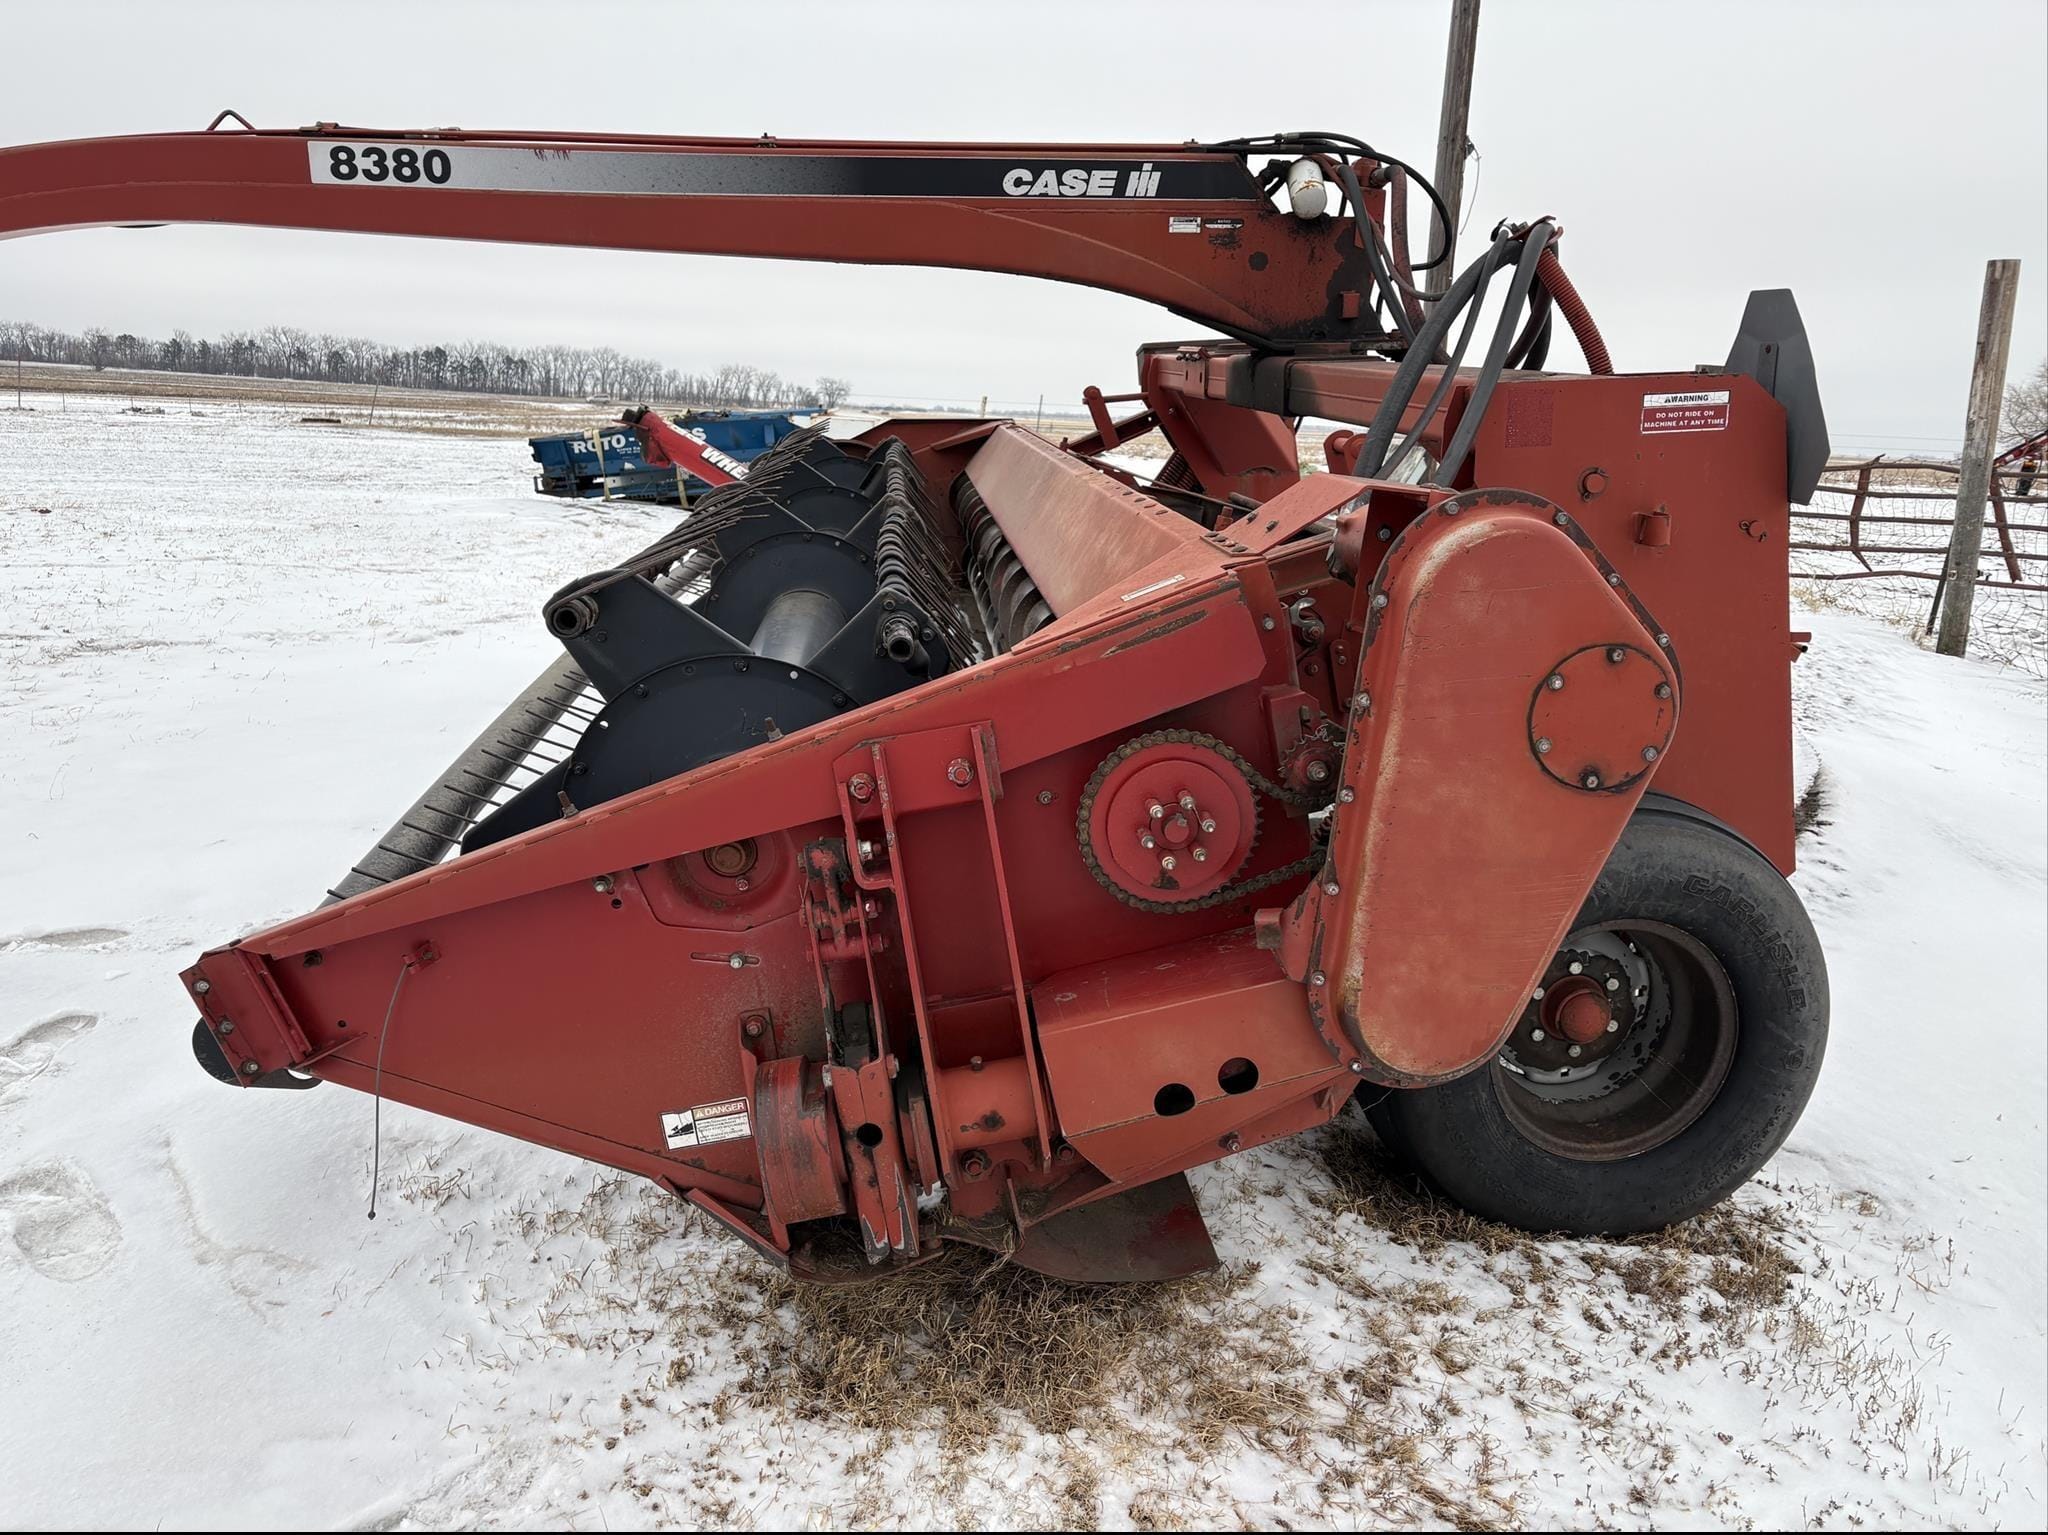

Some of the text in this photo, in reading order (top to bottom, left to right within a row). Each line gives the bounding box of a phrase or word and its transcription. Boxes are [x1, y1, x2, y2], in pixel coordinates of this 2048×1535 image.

[329, 145, 451, 185] 8380
[1002, 168, 1118, 197] CASE
[1671, 394, 1709, 403] WARNING
[1644, 420, 1677, 428] MACHINE
[1682, 874, 1807, 1010] CARLISLE
[704, 1102, 745, 1116] DANGER
